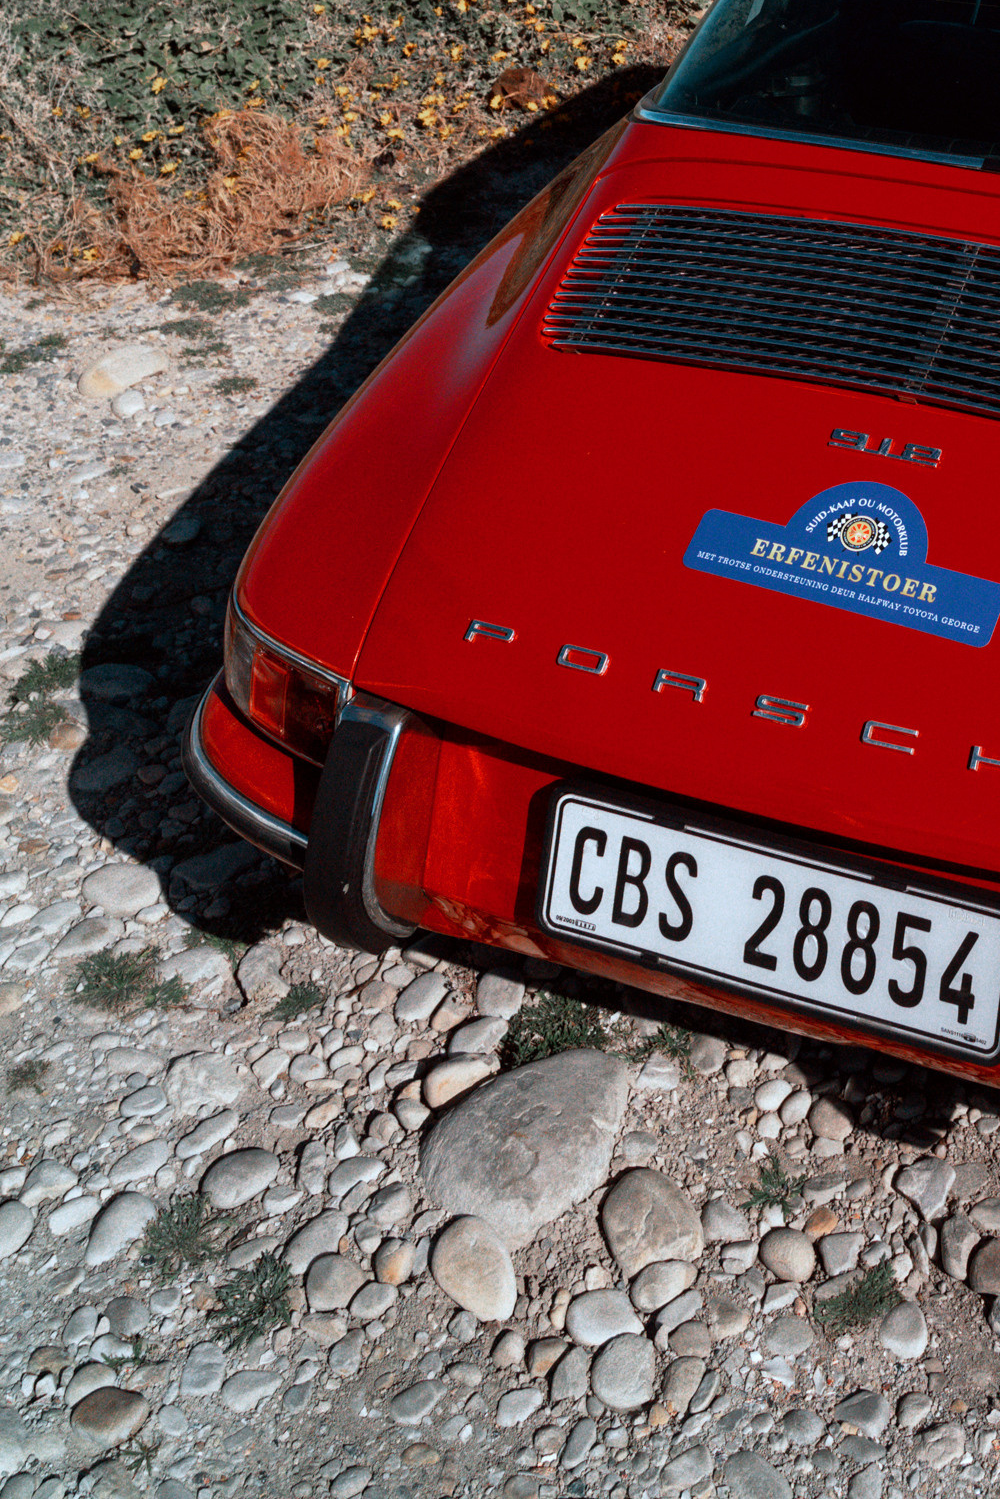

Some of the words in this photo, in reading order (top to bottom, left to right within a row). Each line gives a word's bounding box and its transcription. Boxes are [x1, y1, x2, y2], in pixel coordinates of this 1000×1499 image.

[827, 428, 942, 467] 912
[805, 498, 856, 534] SUID-KAAP
[858, 498, 876, 508] OU
[875, 502, 909, 557] MOTORKLUB
[696, 550, 717, 562] MET
[717, 555, 752, 570] TROTSE
[753, 565, 830, 592] ONDERSTEUNING
[830, 585, 856, 599] DEUR
[857, 592, 901, 611] HALFWAY
[903, 605, 939, 622] TOYOTA
[941, 616, 981, 634] GEORGE
[750, 538, 938, 603] ERFENISTOER
[568, 826, 699, 942] CBS
[742, 874, 980, 1025] 28854
